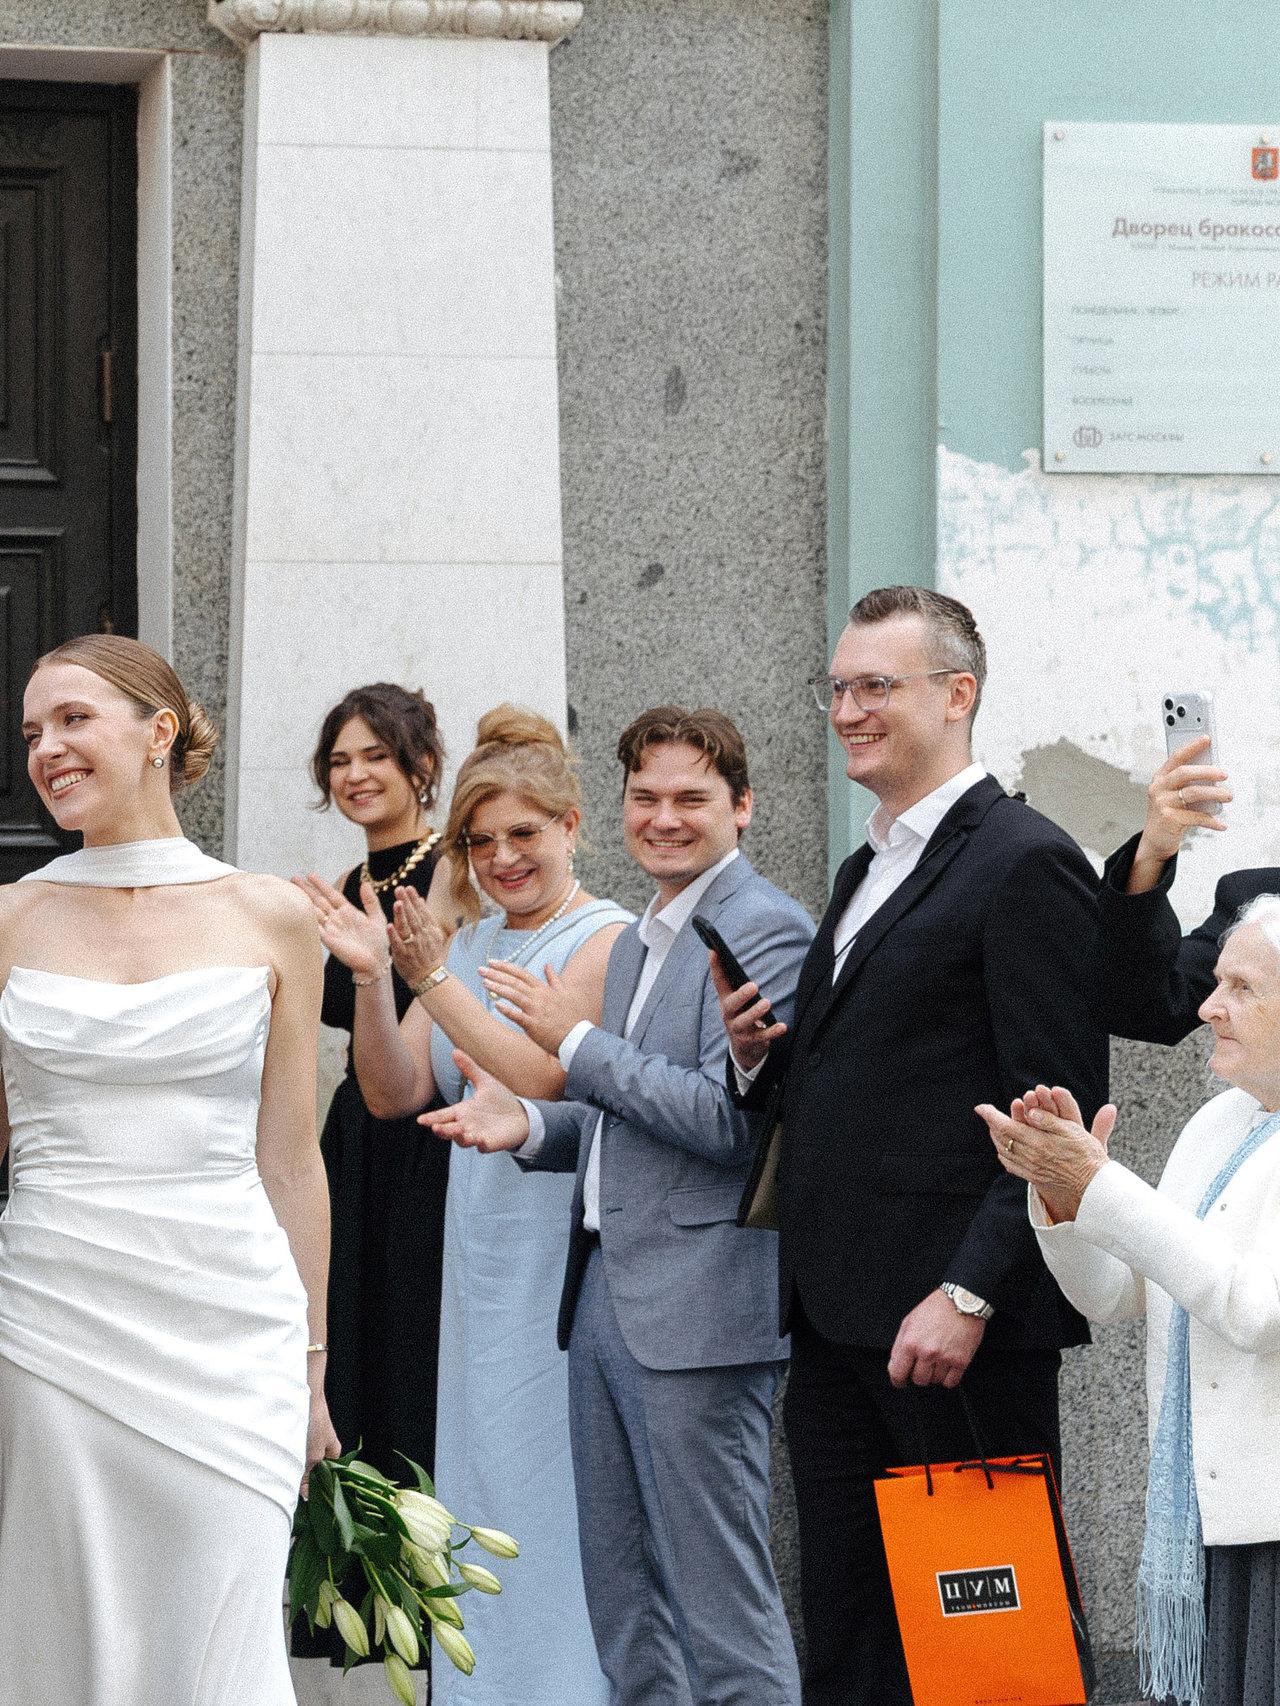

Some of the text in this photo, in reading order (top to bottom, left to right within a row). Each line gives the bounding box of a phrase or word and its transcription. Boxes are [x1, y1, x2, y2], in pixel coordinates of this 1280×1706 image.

[1111, 217, 1193, 240] Дворец
[1191, 270, 1260, 289] РЕЖИМ
[944, 1577, 1010, 1600] ЦУМ
